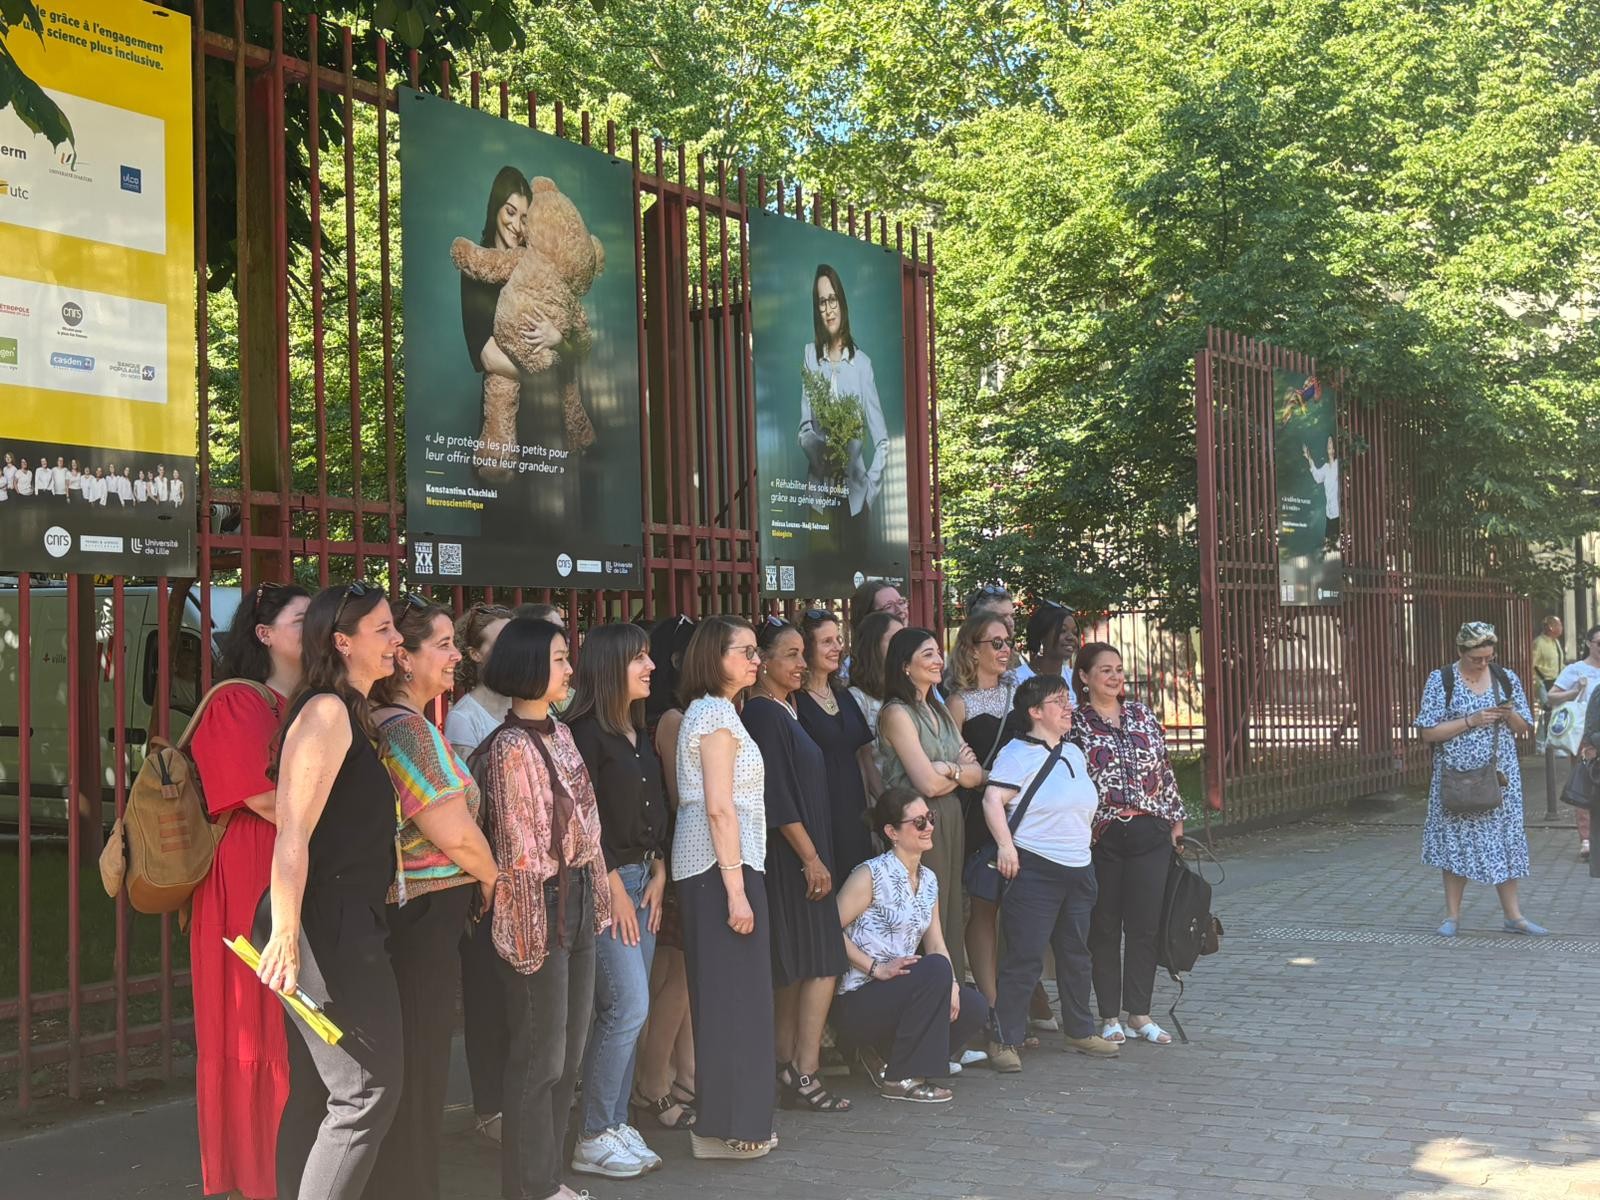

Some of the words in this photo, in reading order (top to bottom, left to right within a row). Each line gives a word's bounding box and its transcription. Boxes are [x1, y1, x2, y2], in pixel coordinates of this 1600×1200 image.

[50, 11, 80, 28] grâce
[83, 19, 90, 32] à
[93, 22, 164, 54] l'engagement
[47, 27, 87, 48] science
[90, 39, 113, 54] plus
[115, 45, 164, 71] inclusive.
[1, 145, 27, 160] erm
[10, 185, 29, 200] utc
[63, 307, 81, 319] cnrs
[53, 356, 82, 367] casden
[433, 431, 445, 444] Je
[446, 436, 485, 451] protège
[487, 438, 500, 451] les
[501, 440, 521, 457] plus
[522, 443, 547, 458] petits
[548, 449, 569, 461] pour
[425, 447, 444, 461] leur
[446, 450, 470, 464] offrir
[472, 454, 497, 467] toute
[499, 456, 517, 469] leur
[518, 461, 558, 473] grandeur
[425, 483, 466, 496] Konstantina
[775, 478, 808, 491] Réhabiliter
[808, 481, 817, 492] les
[817, 482, 829, 493] sols
[829, 484, 850, 496] pollués
[426, 496, 484, 511] Neuroscientifique
[770, 491, 789, 504] grâce
[789, 494, 797, 503] au
[797, 494, 814, 507] génie
[815, 497, 837, 508] végétal
[46, 534, 70, 546] cnrs
[144, 537, 179, 548] Université
[144, 547, 154, 555] de
[155, 547, 170, 555] Lille
[415, 552, 433, 566] XX
